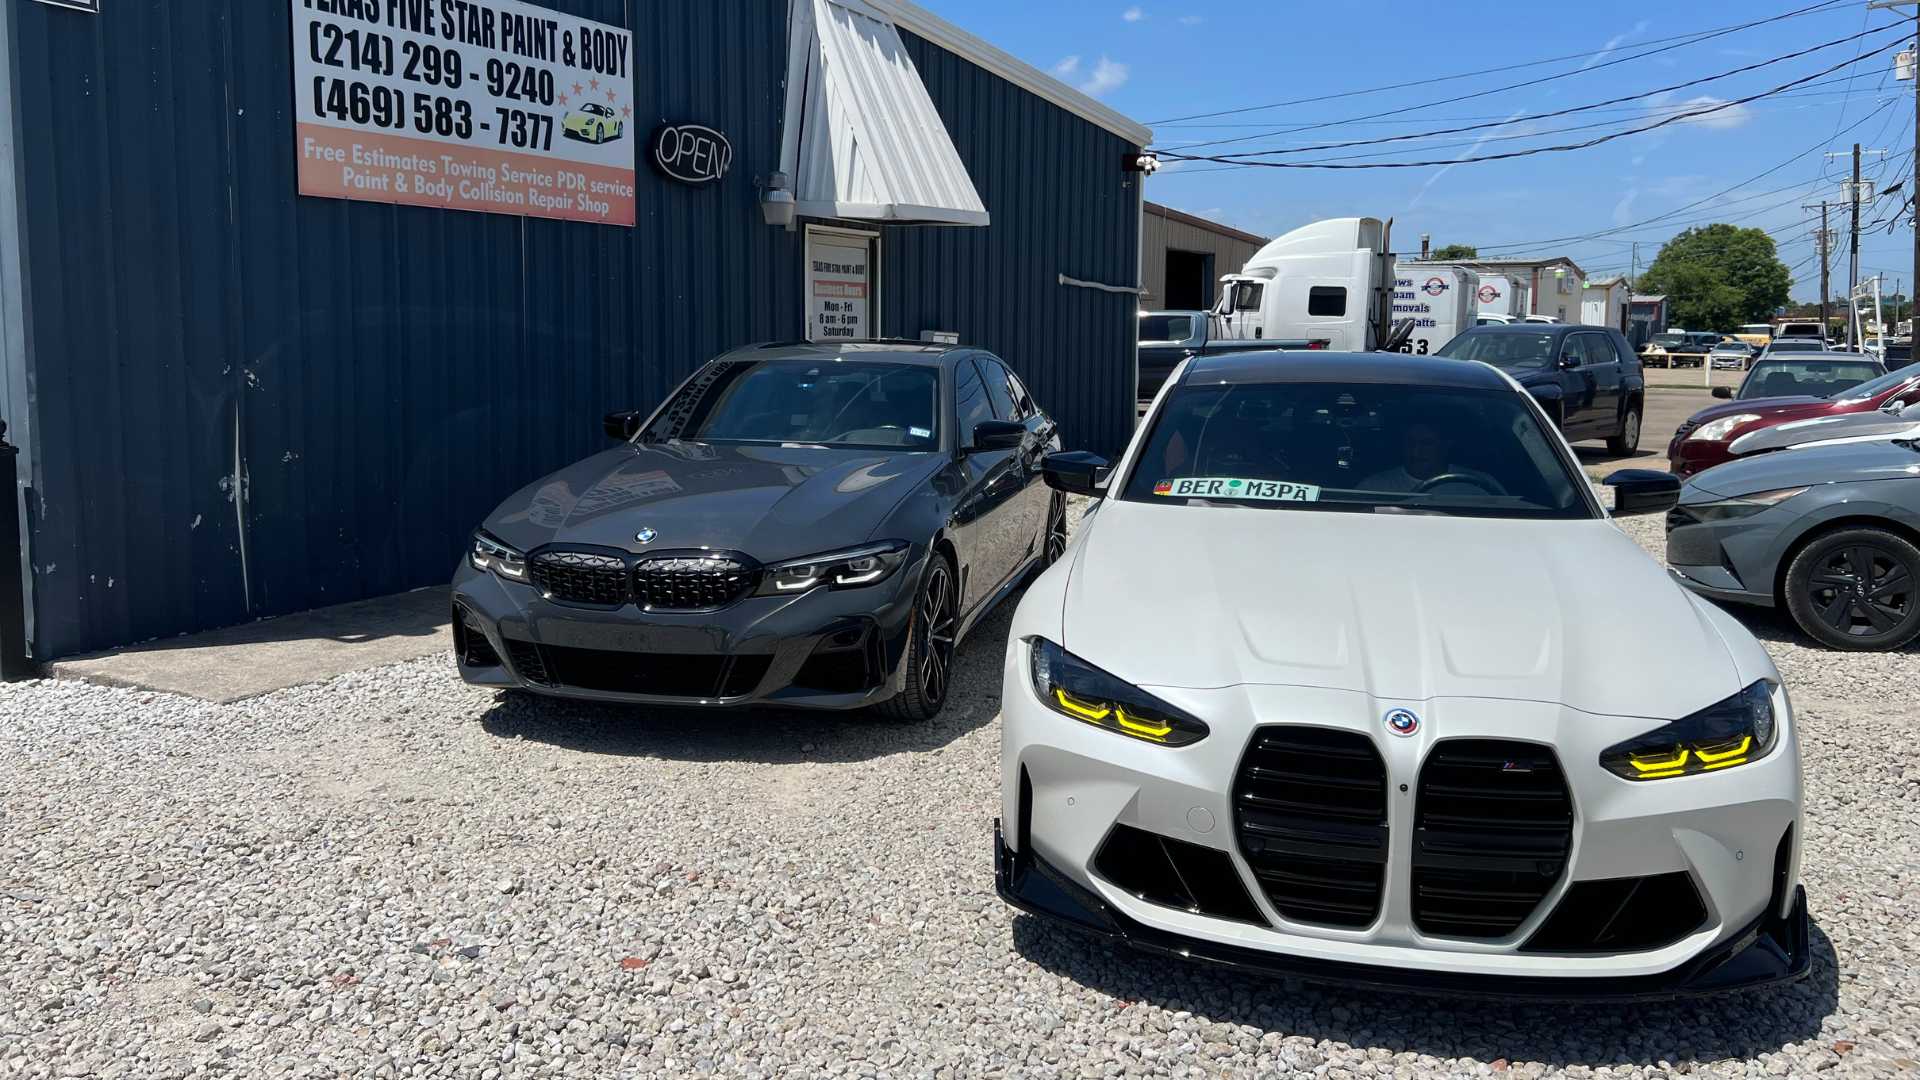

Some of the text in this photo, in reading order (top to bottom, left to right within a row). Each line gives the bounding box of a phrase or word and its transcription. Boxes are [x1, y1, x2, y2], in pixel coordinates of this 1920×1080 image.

[387, 0, 436, 36] FIVE
[440, 0, 496, 50] STAR
[500, 11, 558, 63] PAINT
[562, 30, 577, 67] &
[580, 26, 628, 78] BODY
[309, 21, 394, 76] (214)
[402, 41, 462, 89] 299
[486, 58, 554, 106] 9240
[313, 76, 405, 129] (469)
[413, 93, 473, 139] 583
[495, 107, 554, 151] 7377
[303, 137, 634, 198] Free Estimates Towing Service PDR service
[659, 126, 727, 179] OPEN
[342, 166, 610, 216] Paint & Body Collision Repair Shop
[824, 301, 839, 312] Mon
[844, 302, 853, 313] Fri
[1392, 291, 1415, 299] oam
[1392, 304, 1430, 312] movals
[823, 326, 854, 338] Saturday
[825, 316, 836, 325] am
[847, 315, 858, 326] pm
[1177, 480, 1310, 500] BER M3PÄ
